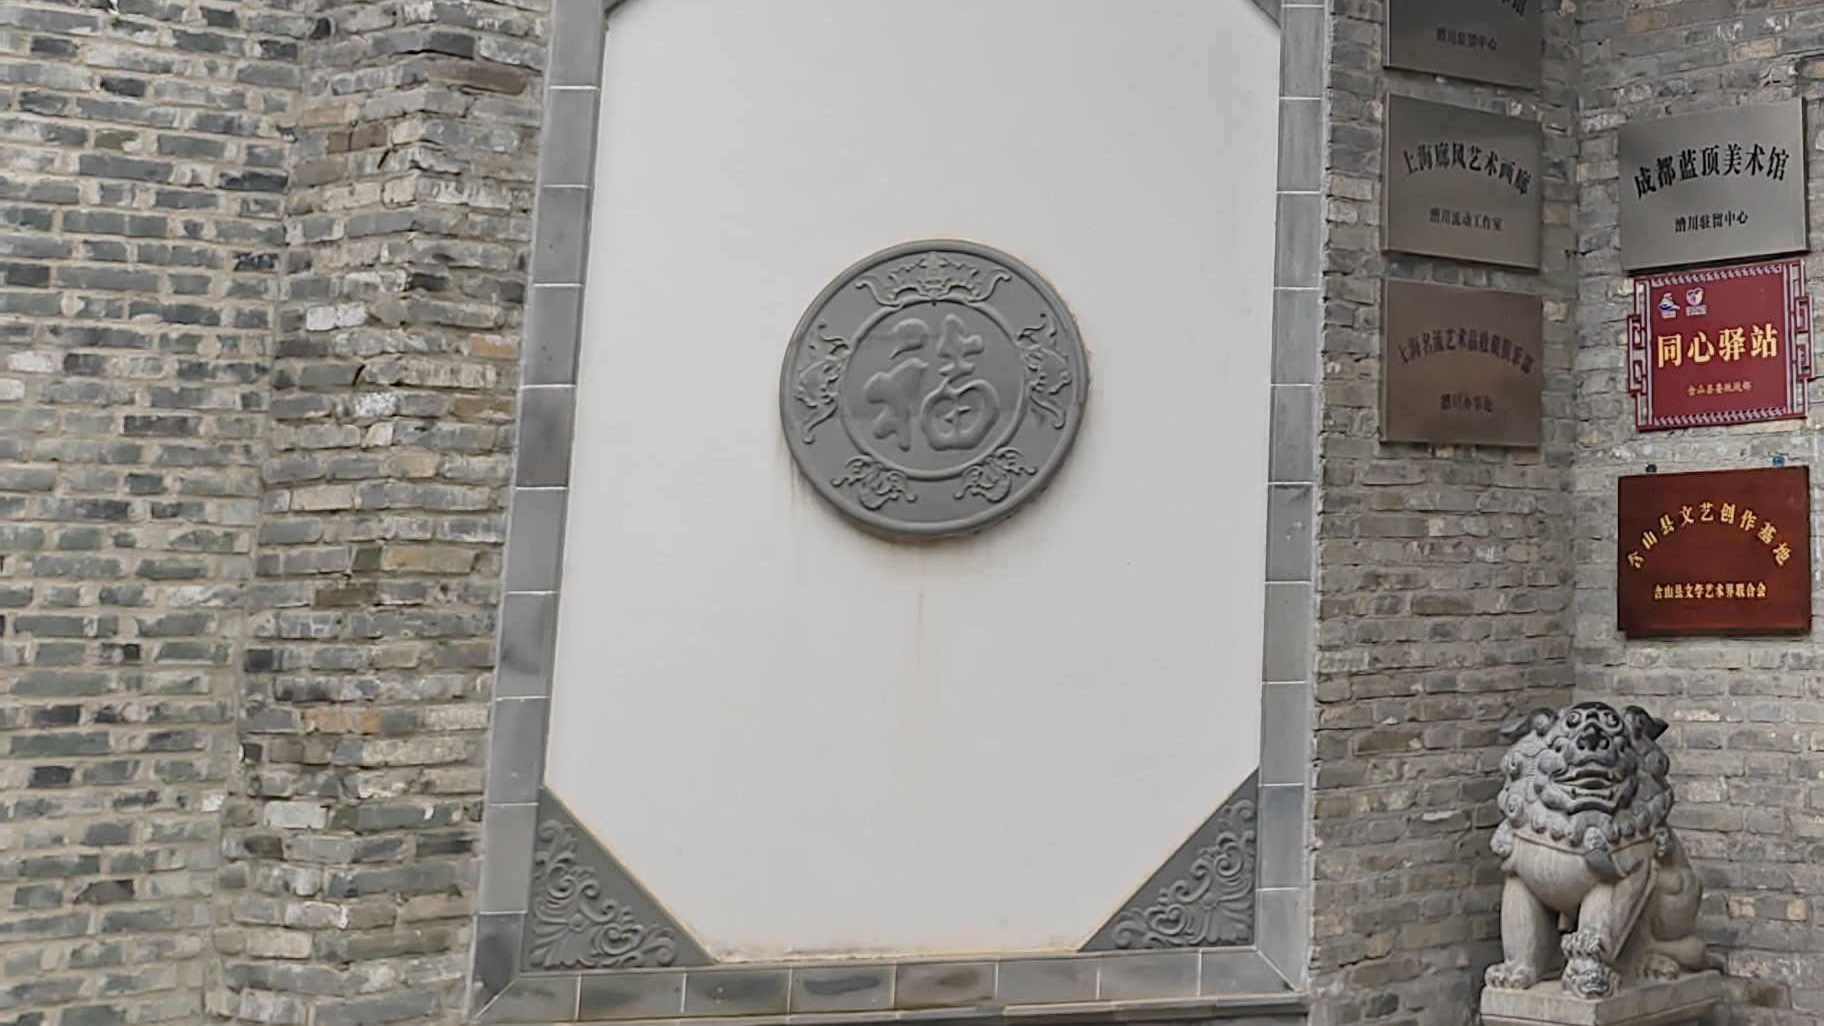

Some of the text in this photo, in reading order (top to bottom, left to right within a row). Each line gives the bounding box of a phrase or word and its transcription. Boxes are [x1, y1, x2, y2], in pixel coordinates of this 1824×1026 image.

[1633, 142, 1790, 200] 成都蓝顶美术馆
[1657, 322, 1779, 369] 同心驿站
[1627, 502, 1793, 568] 含山县文艺创作基地
[1654, 581, 1768, 601] 含山县文学艺术界联合会
